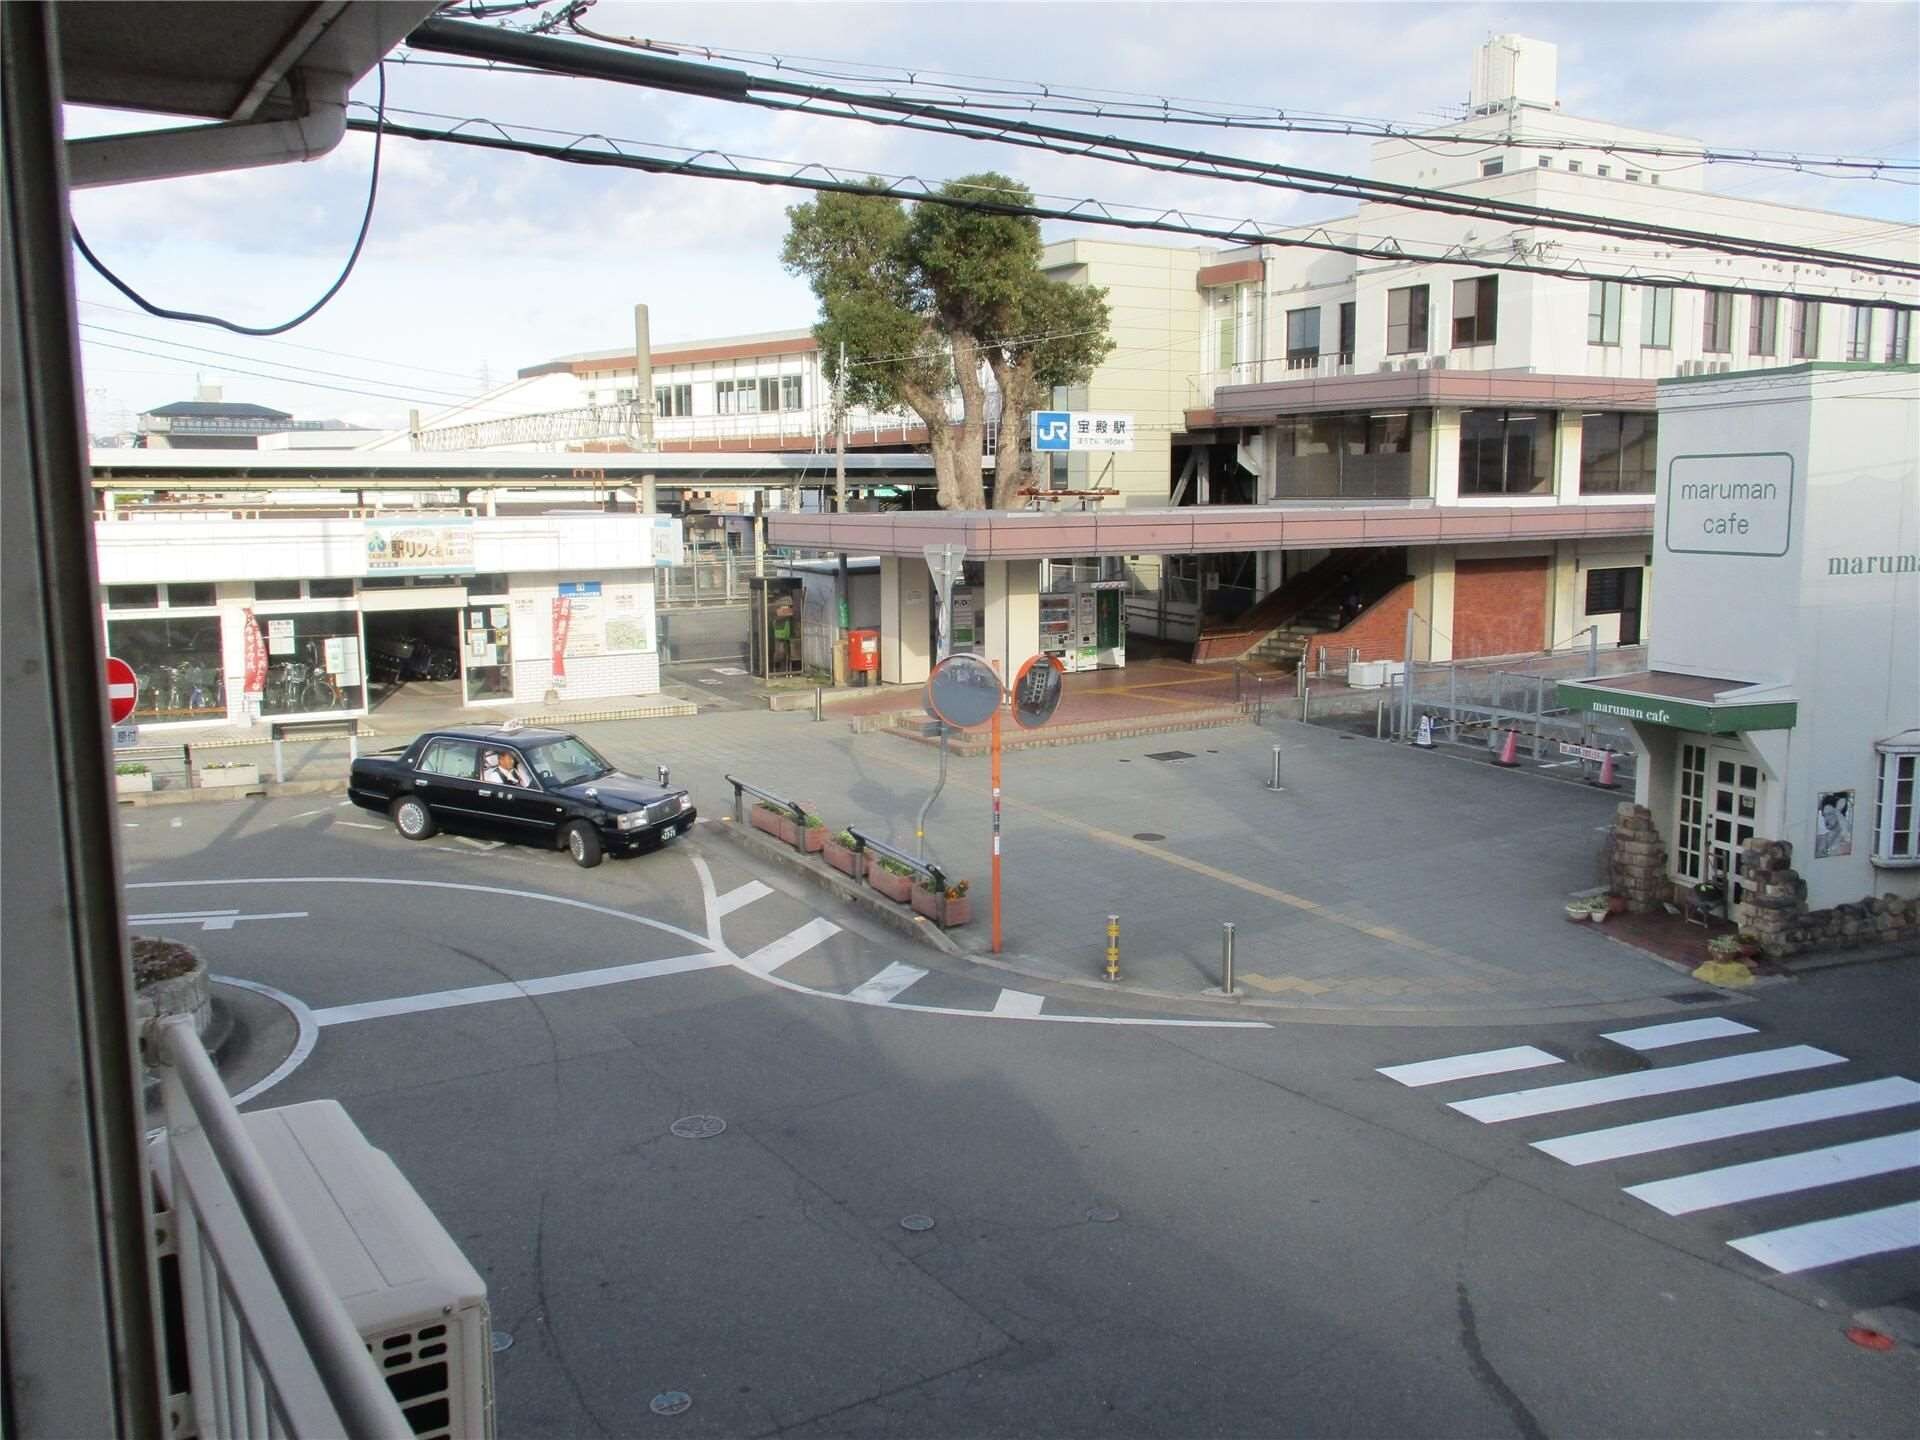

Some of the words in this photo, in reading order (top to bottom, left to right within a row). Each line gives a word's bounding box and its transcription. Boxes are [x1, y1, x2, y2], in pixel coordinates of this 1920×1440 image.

[1040, 422, 1067, 440] JR
[1078, 420, 1126, 434] 宝殿駅
[1681, 482, 1776, 500] maruman
[1703, 512, 1750, 535] cafe
[1592, 702, 1643, 719] maruman
[1646, 709, 1671, 723] cafe
